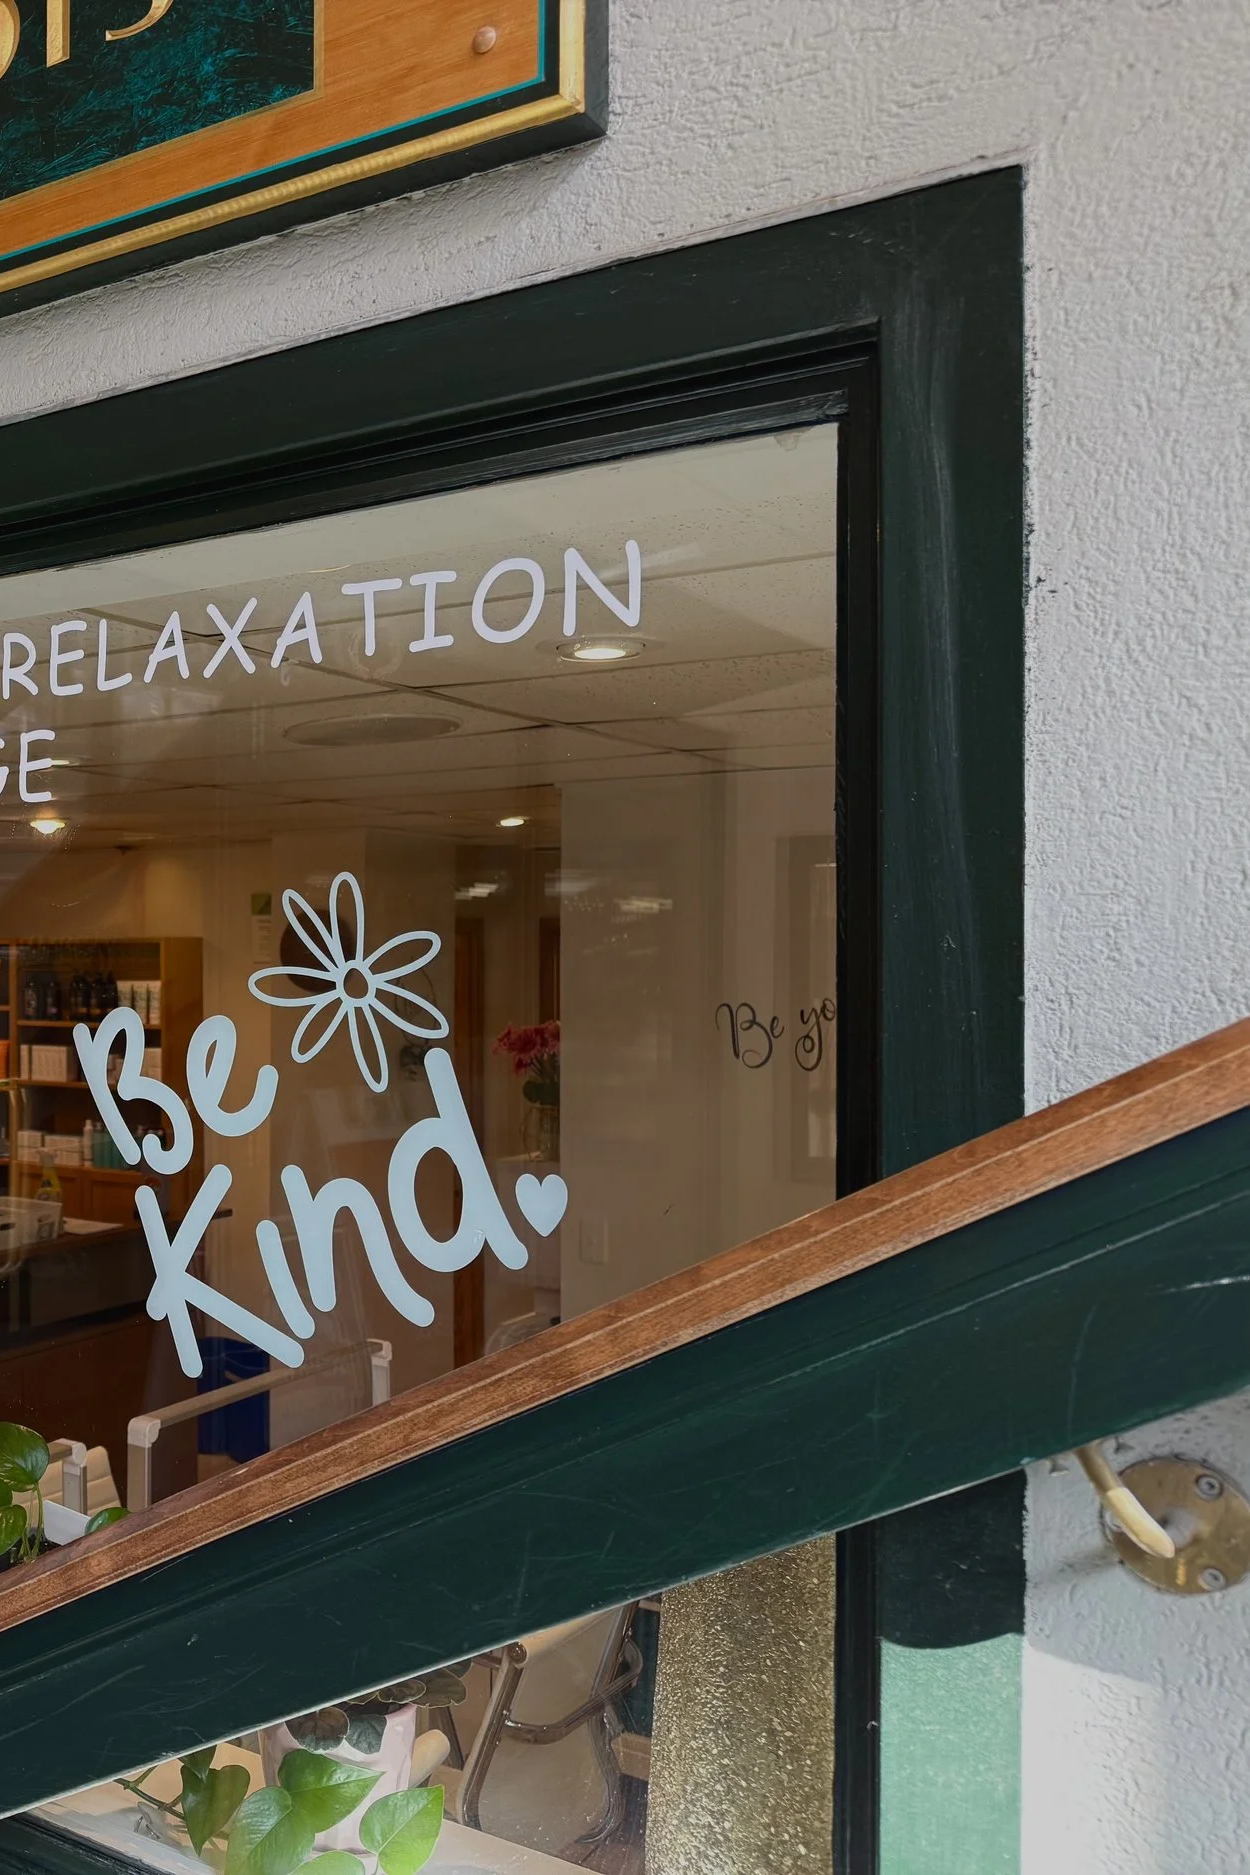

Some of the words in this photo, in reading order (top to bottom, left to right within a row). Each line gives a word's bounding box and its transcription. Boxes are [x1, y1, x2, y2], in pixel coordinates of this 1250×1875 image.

[2, 540, 642, 700] RELAXATION
[72, 1006, 279, 1175] Be
[715, 1001, 785, 1069] Be
[134, 1046, 529, 1378] Kind
